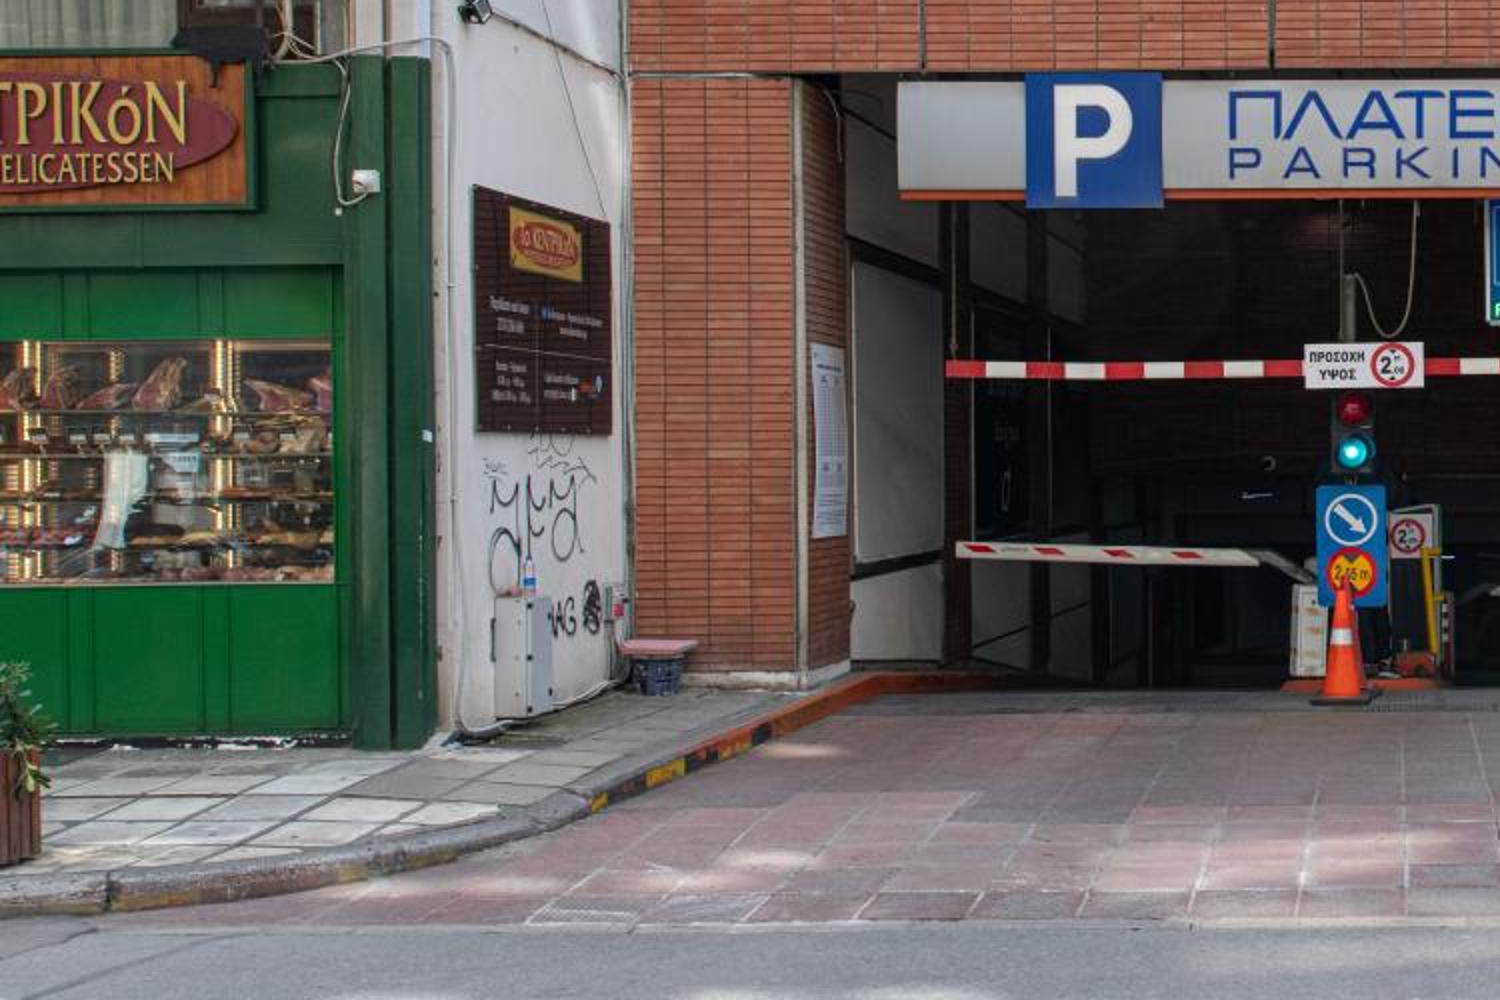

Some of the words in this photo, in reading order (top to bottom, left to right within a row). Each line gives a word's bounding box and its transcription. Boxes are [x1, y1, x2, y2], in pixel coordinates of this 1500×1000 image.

[1053, 84, 1132, 197] P
[1308, 351, 1366, 363] ΠΡΟΣΟΧΗ
[1319, 369, 1357, 381] ΥΨΟΣ
